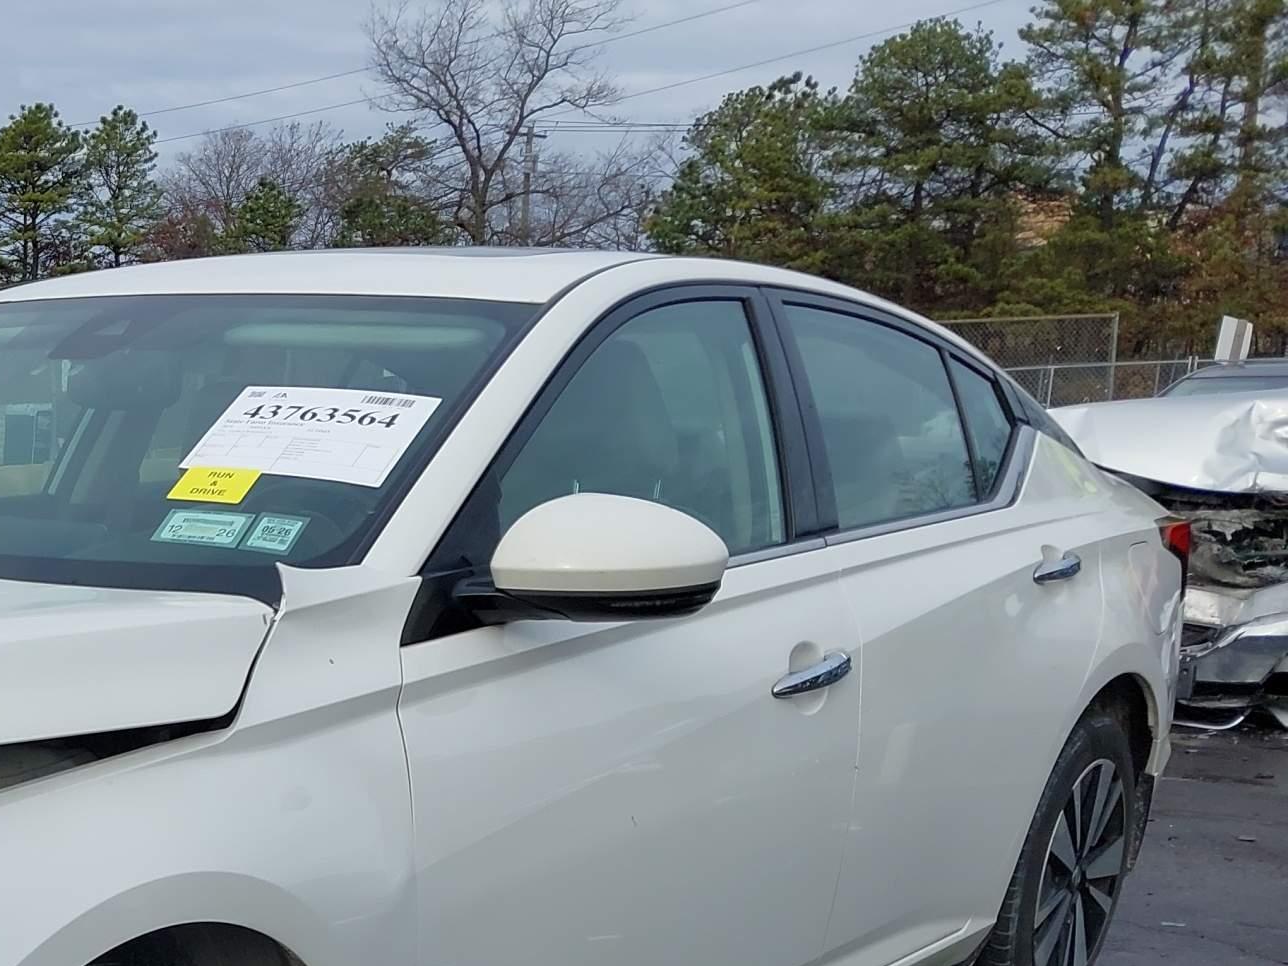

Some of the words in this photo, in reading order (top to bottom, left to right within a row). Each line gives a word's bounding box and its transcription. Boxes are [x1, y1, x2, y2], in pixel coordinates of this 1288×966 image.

[243, 403, 400, 429] 43763564
[208, 471, 234, 479] RUN
[189, 487, 227, 496] DRIVE
[168, 525, 183, 534] 12
[215, 528, 237, 538] 26
